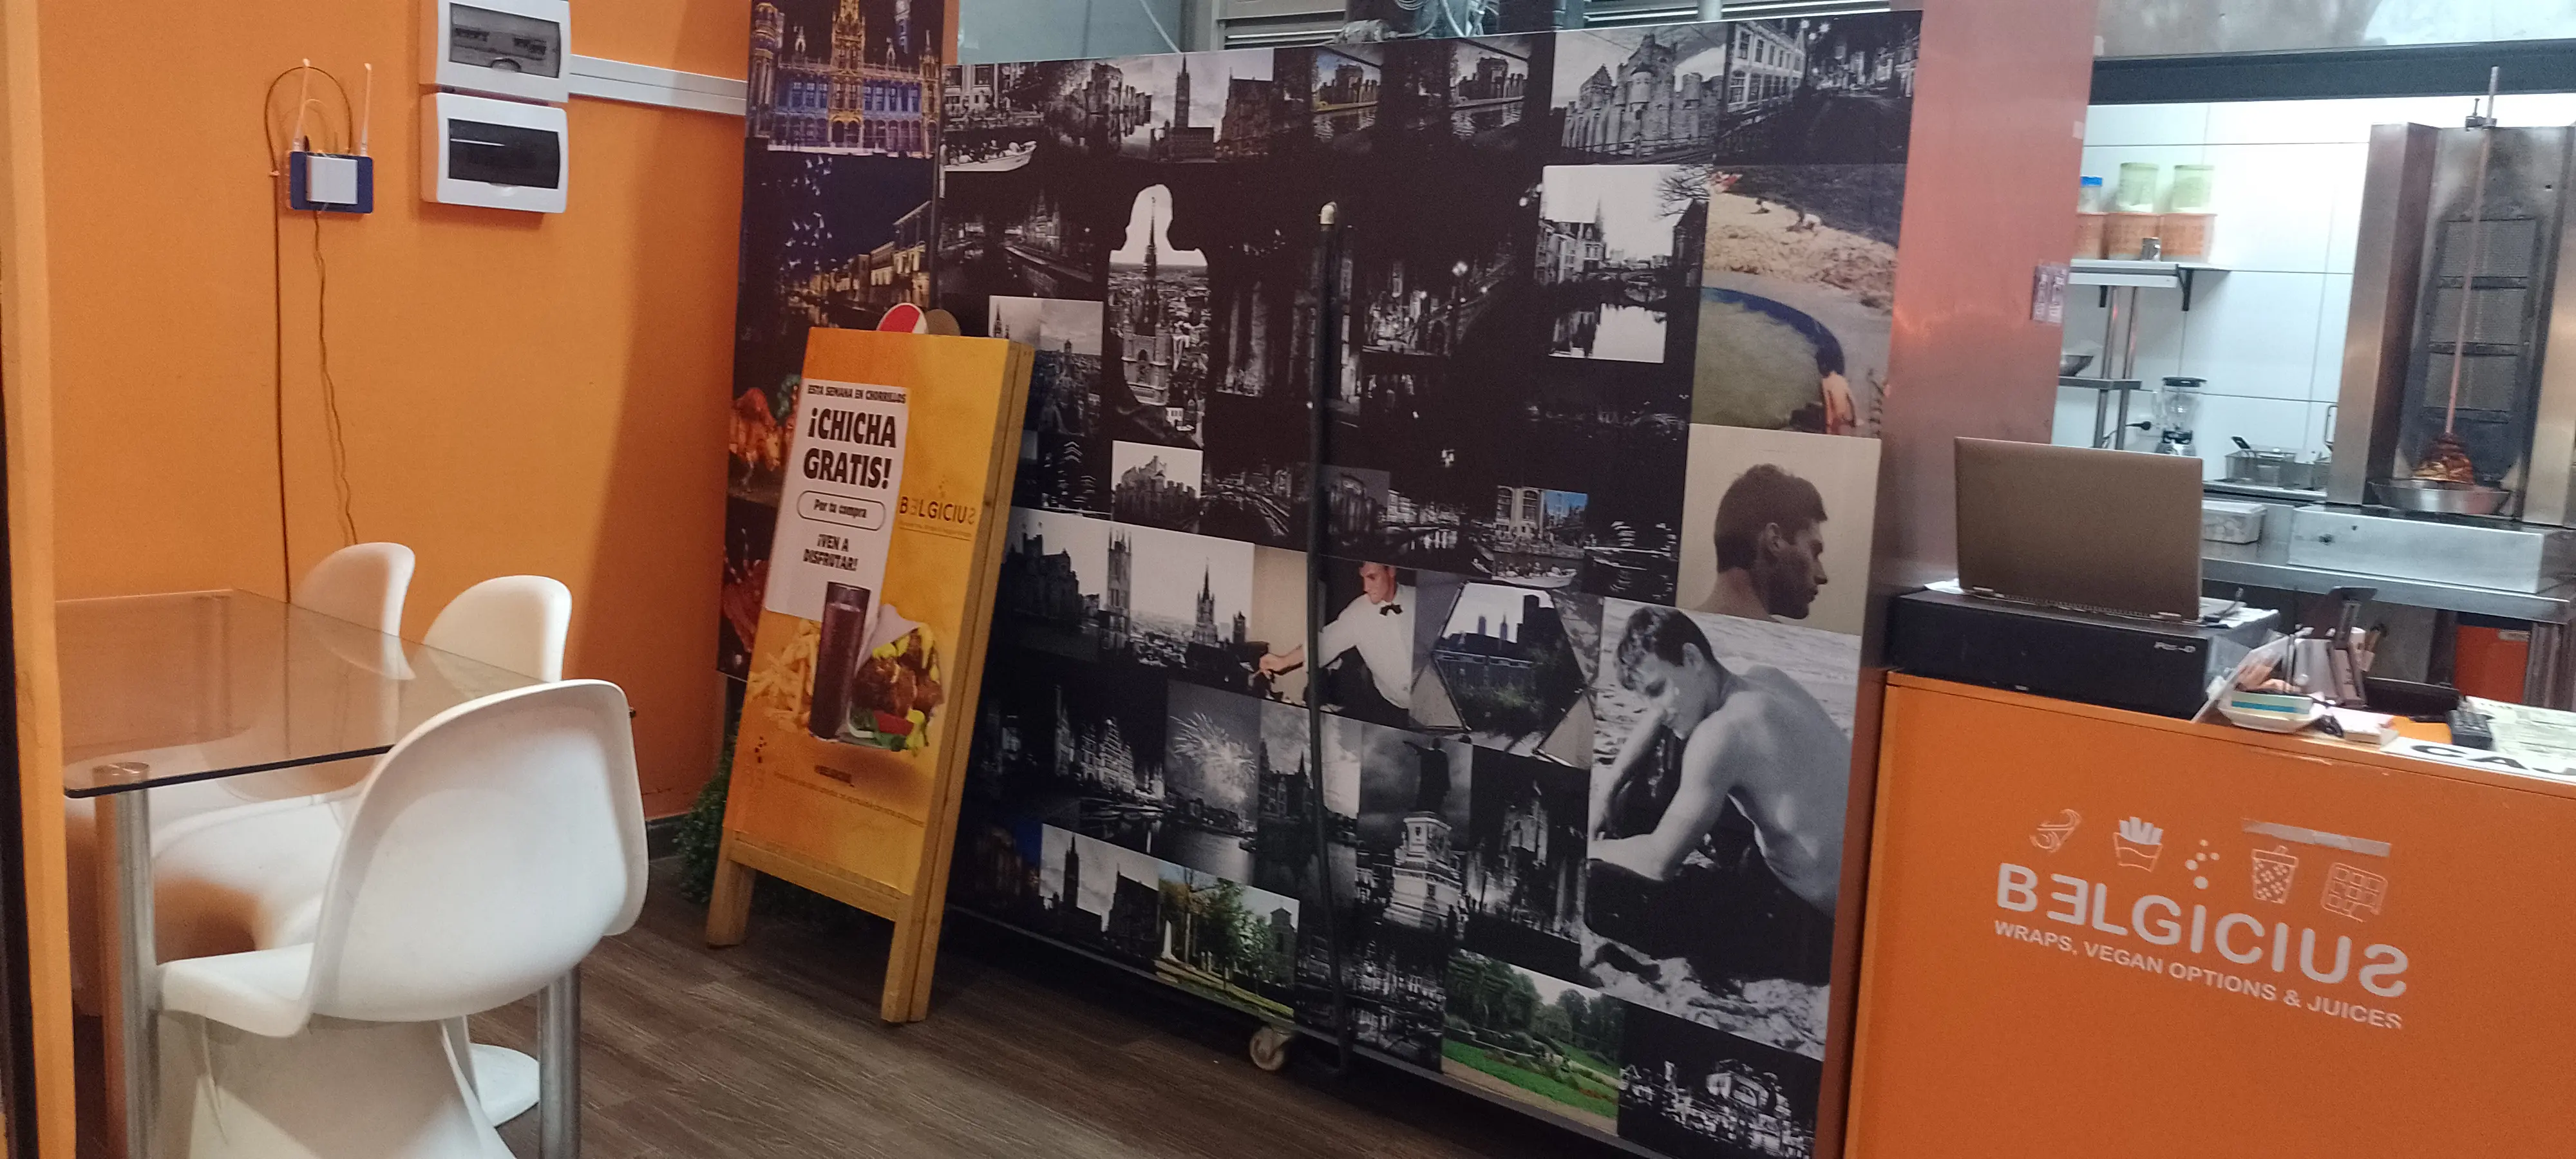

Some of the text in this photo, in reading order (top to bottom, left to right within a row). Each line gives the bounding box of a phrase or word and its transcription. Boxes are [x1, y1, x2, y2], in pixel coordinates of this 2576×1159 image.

[808, 408, 896, 448] ¡CHICHA
[803, 448, 893, 489] GRATIS!
[813, 498, 828, 511] Por
[841, 538, 849, 552] A
[2083, 940, 2164, 974] VEGAN
[2168, 961, 2277, 1001] OPTIONS
[2282, 988, 2302, 1008] &
[2307, 995, 2403, 1030] JUICES
